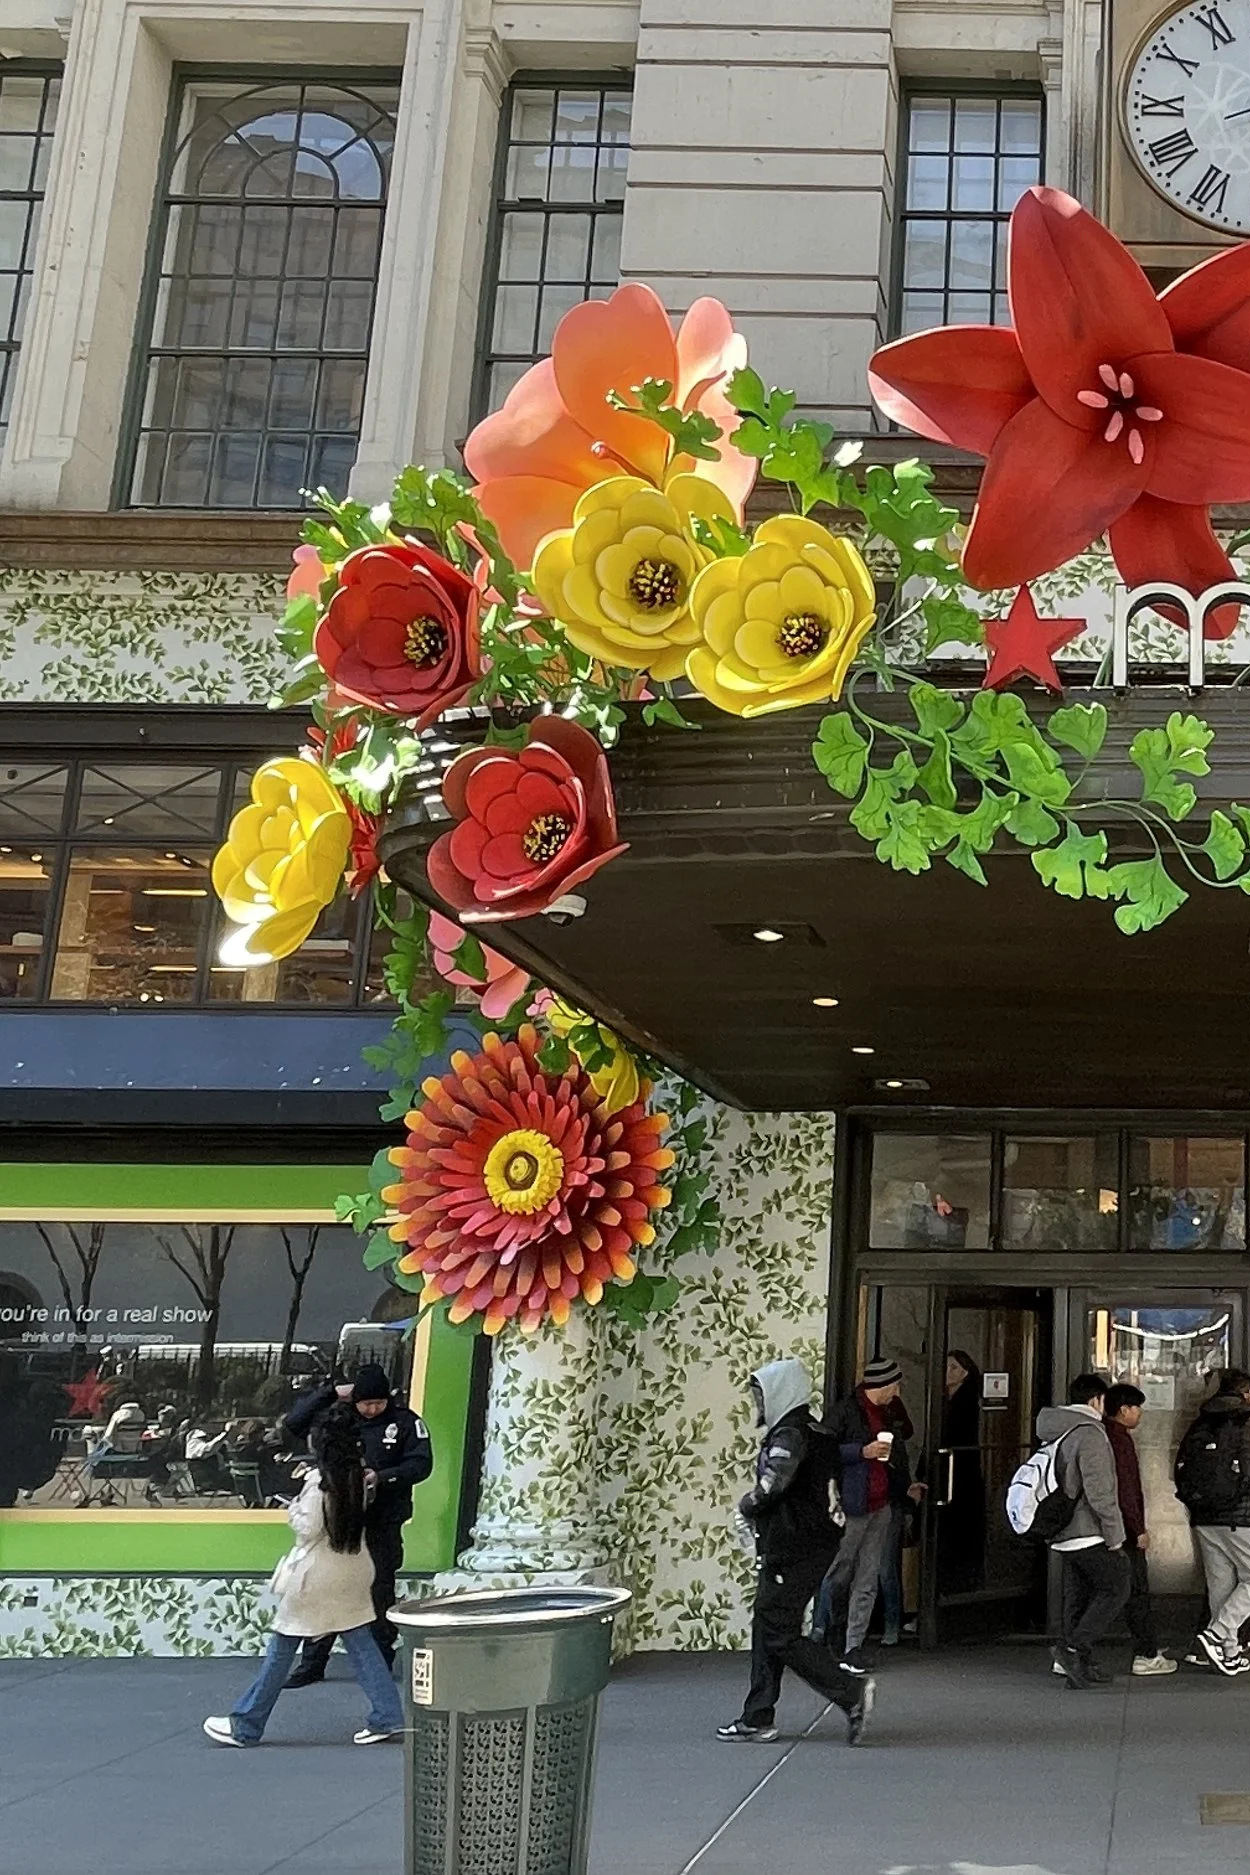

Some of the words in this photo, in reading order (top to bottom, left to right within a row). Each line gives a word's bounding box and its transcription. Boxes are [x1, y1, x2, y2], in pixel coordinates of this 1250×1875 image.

[1195, 8, 1236, 50] XI
[1156, 43, 1200, 78] X
[1141, 94, 1185, 117] IX
[1148, 128, 1199, 178] VIII
[1189, 164, 1231, 213] VII
[0, 1304, 49, 1322] ou're
[54, 1305, 70, 1322] in
[76, 1305, 100, 1322] for
[105, 1308, 118, 1322] a
[122, 1305, 158, 1322] real
[162, 1306, 214, 1322] show
[21, 1331, 50, 1343] think
[52, 1331, 65, 1343] of
[67, 1331, 87, 1343] this
